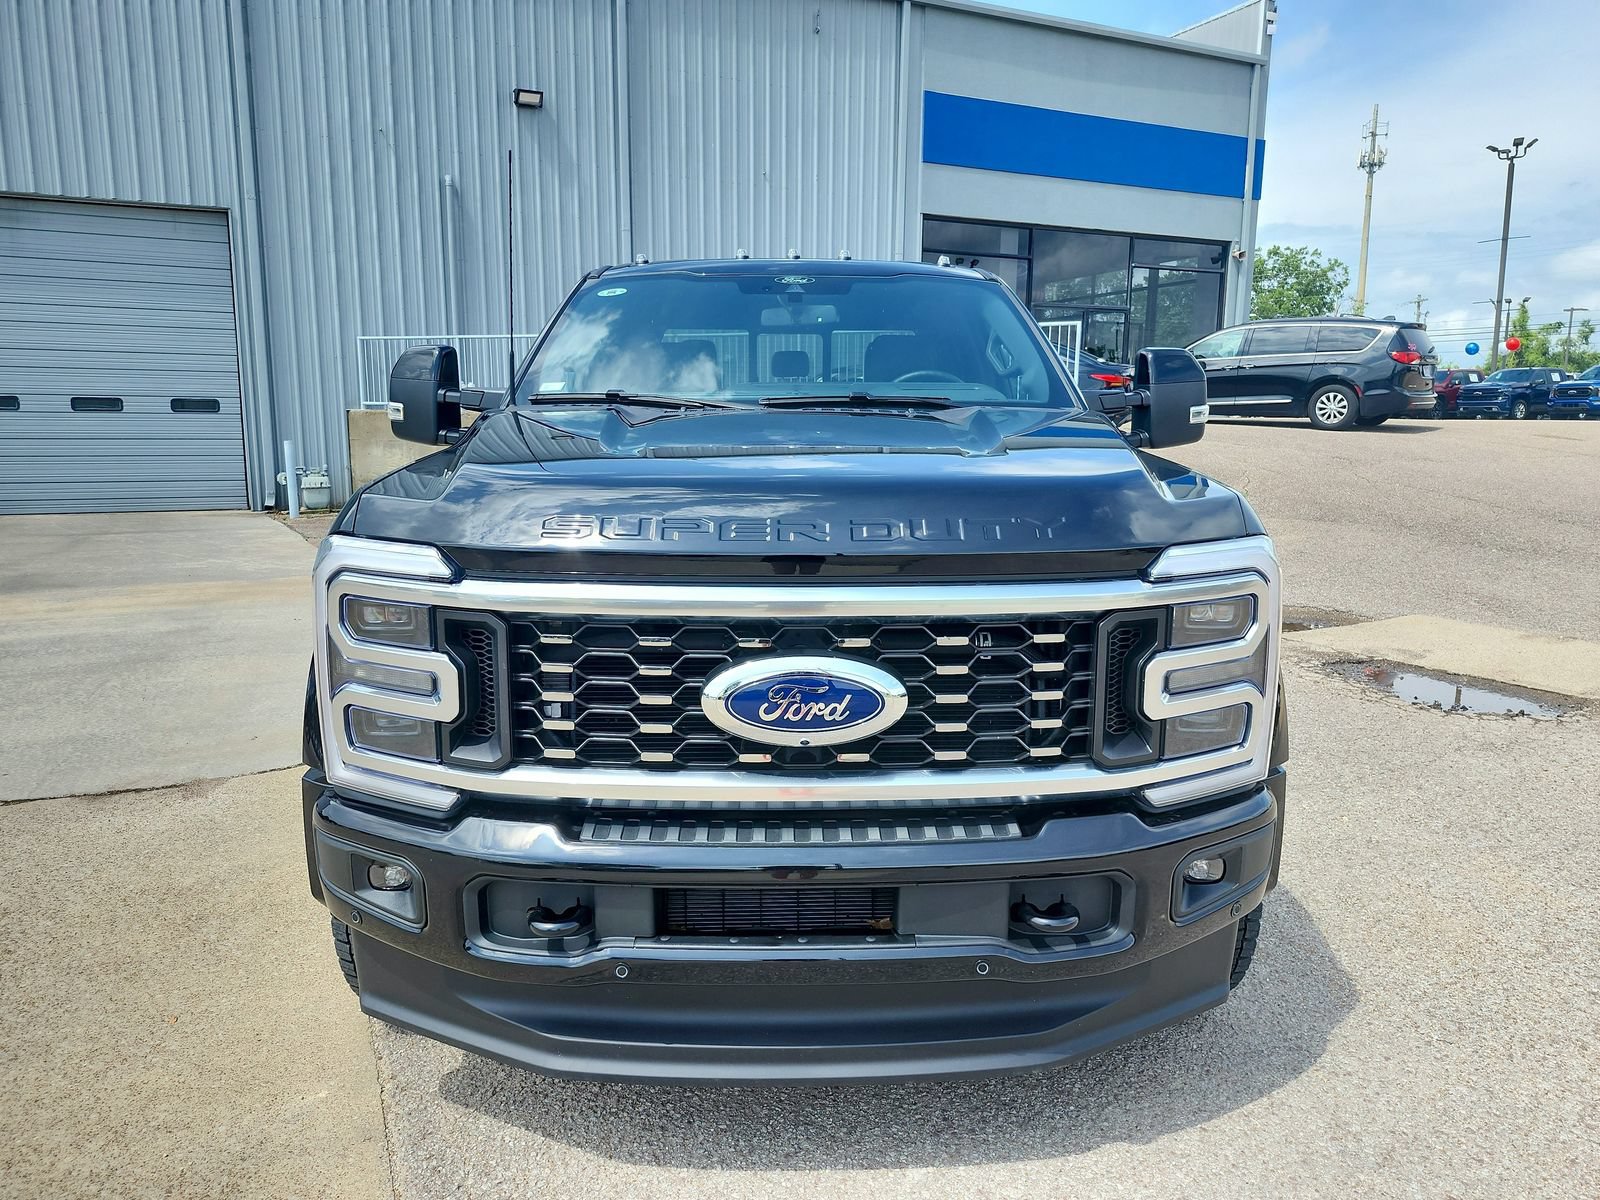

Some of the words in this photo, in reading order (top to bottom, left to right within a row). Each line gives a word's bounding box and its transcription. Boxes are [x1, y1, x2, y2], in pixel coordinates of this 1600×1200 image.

[540, 514, 831, 541] SUPER
[849, 517, 1067, 541] DUTY
[758, 684, 853, 722] Ford
